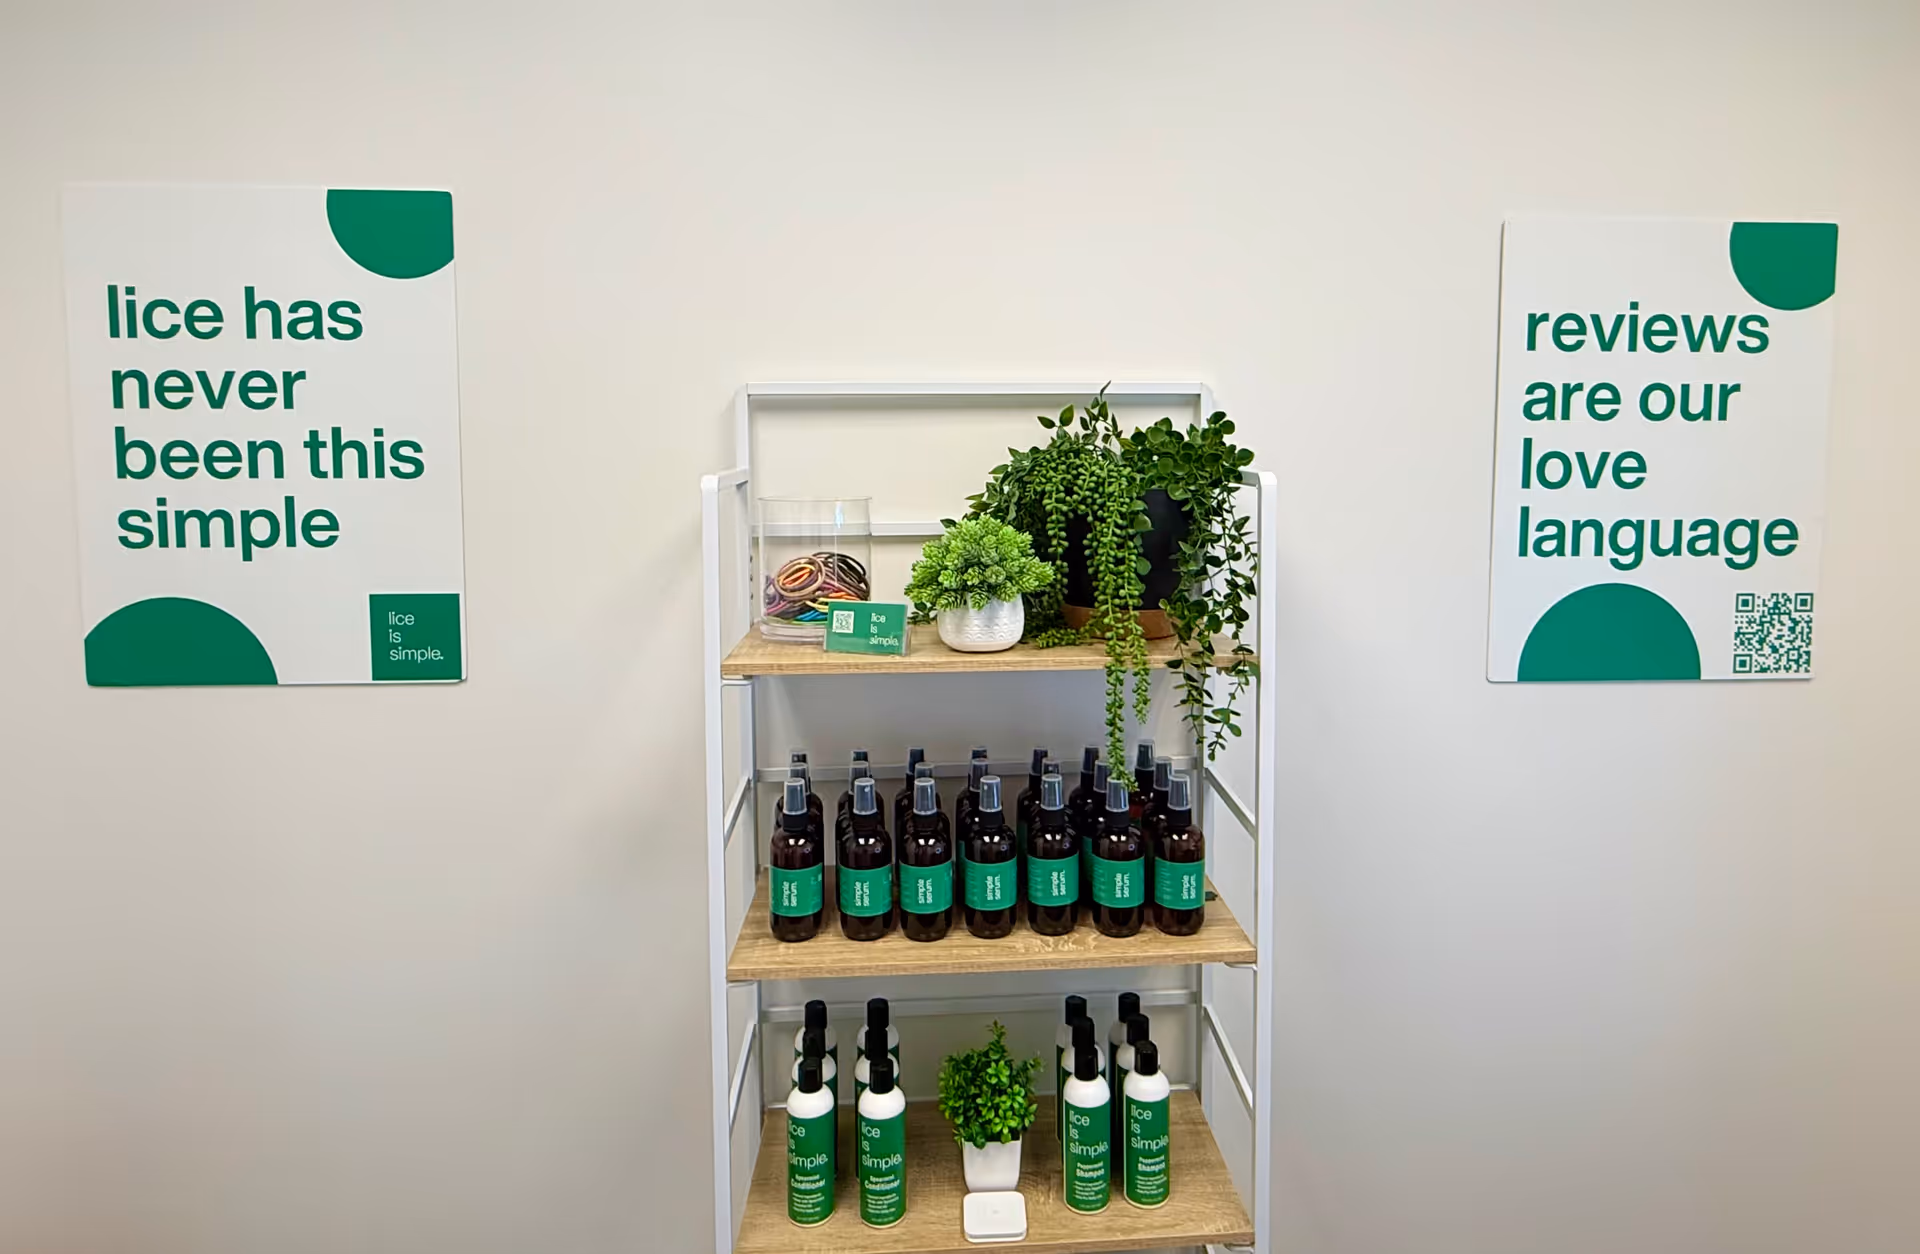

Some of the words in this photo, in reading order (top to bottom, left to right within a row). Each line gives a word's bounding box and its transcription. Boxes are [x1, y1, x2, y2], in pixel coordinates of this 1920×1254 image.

[107, 284, 224, 340] lice
[244, 285, 363, 341] has
[1526, 301, 1770, 354] reviews
[111, 369, 307, 411] never
[1522, 381, 1622, 422] are
[1638, 382, 1741, 422] our
[114, 425, 285, 480] been
[302, 426, 425, 480] this
[1520, 437, 1647, 490] love
[117, 495, 340, 562] simple
[1517, 505, 1800, 572] language
[388, 611, 415, 626] lice
[870, 612, 886, 623] lice
[870, 623, 878, 634] is
[388, 628, 402, 643] is
[389, 645, 444, 664] simple.
[782, 881, 790, 907] simple
[853, 881, 862, 907] simple
[917, 878, 925, 904] simple
[986, 875, 994, 900] simple
[1051, 871, 1059, 897] simple
[1114, 873, 1122, 898] simple
[1181, 874, 1190, 900] simple
[1069, 1109, 1090, 1126] lice
[1130, 1104, 1152, 1120] lice
[1069, 1124, 1079, 1139] is
[1130, 1119, 1141, 1134] is
